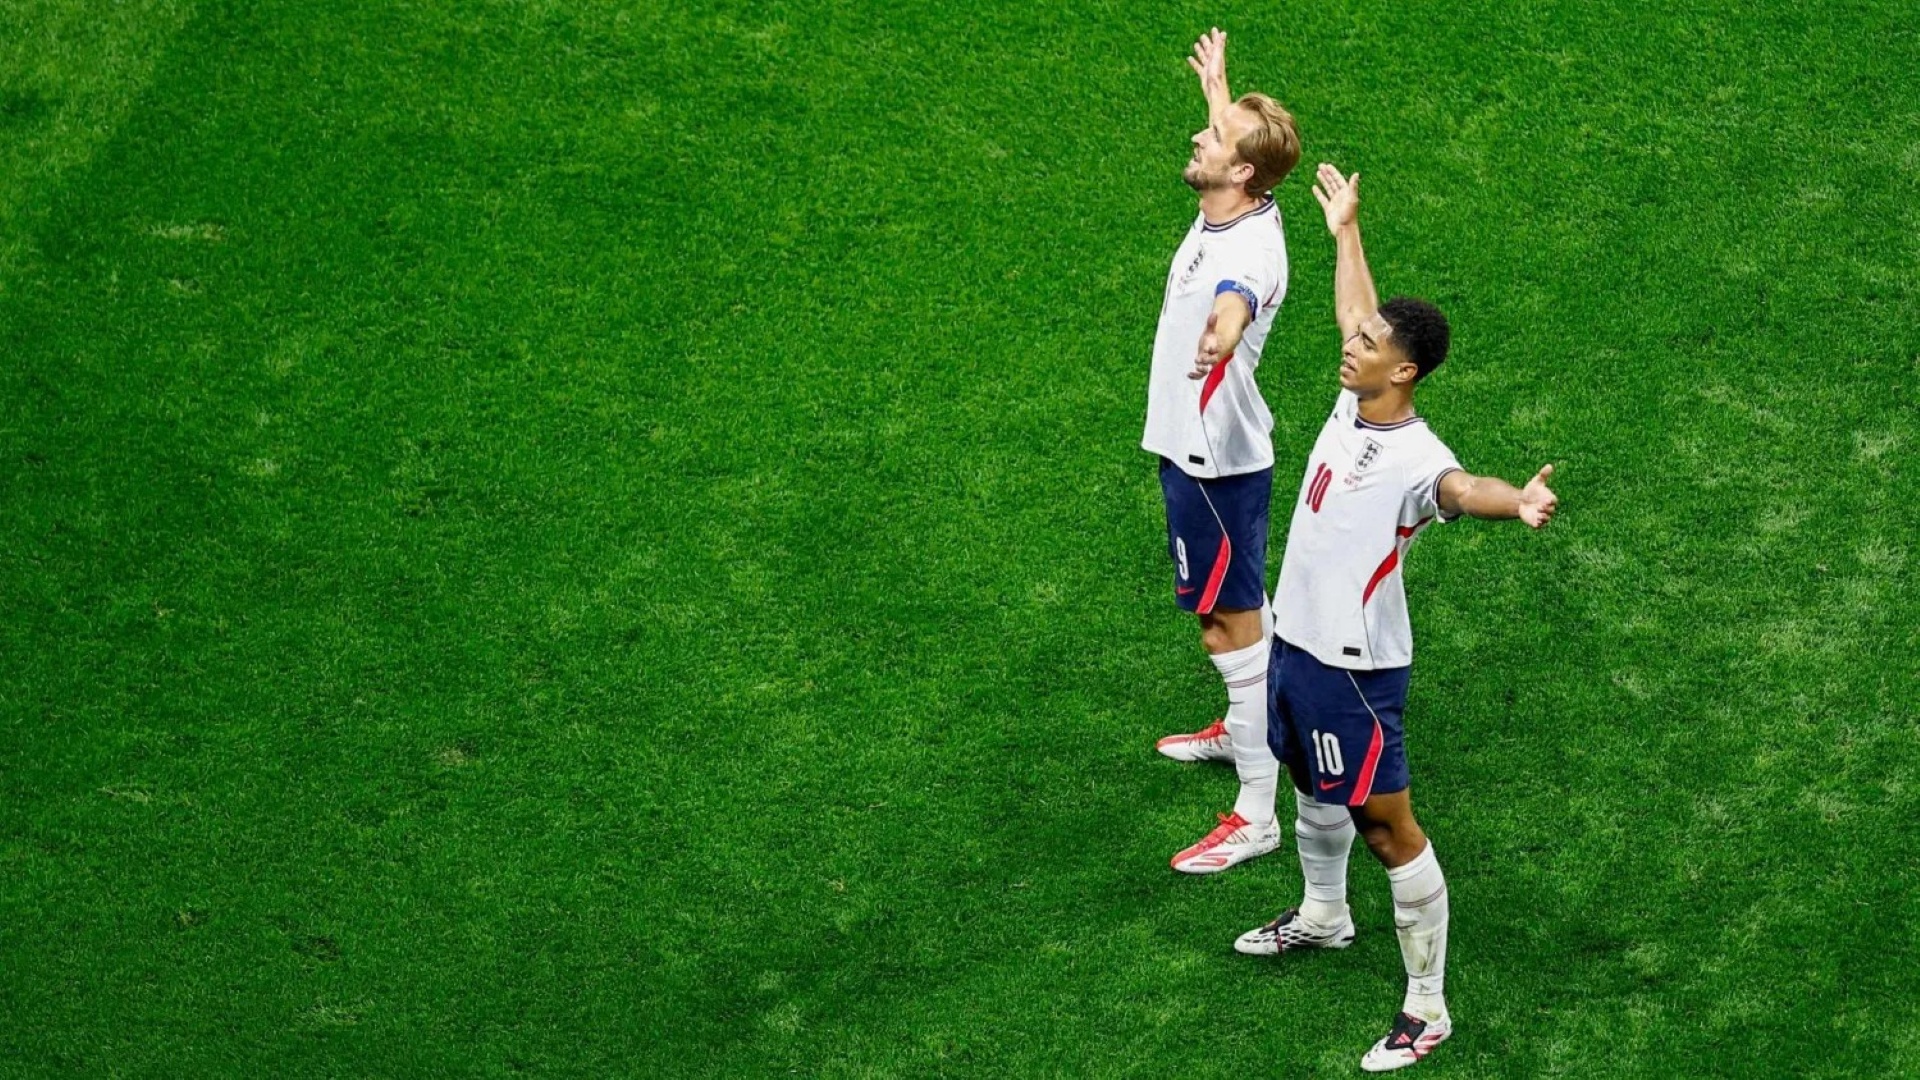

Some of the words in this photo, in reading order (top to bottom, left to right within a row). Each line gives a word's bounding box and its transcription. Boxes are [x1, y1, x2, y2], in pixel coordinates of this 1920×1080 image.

[1305, 462, 1332, 513] 10
[1176, 536, 1189, 581] 9
[1312, 729, 1344, 776] 10
